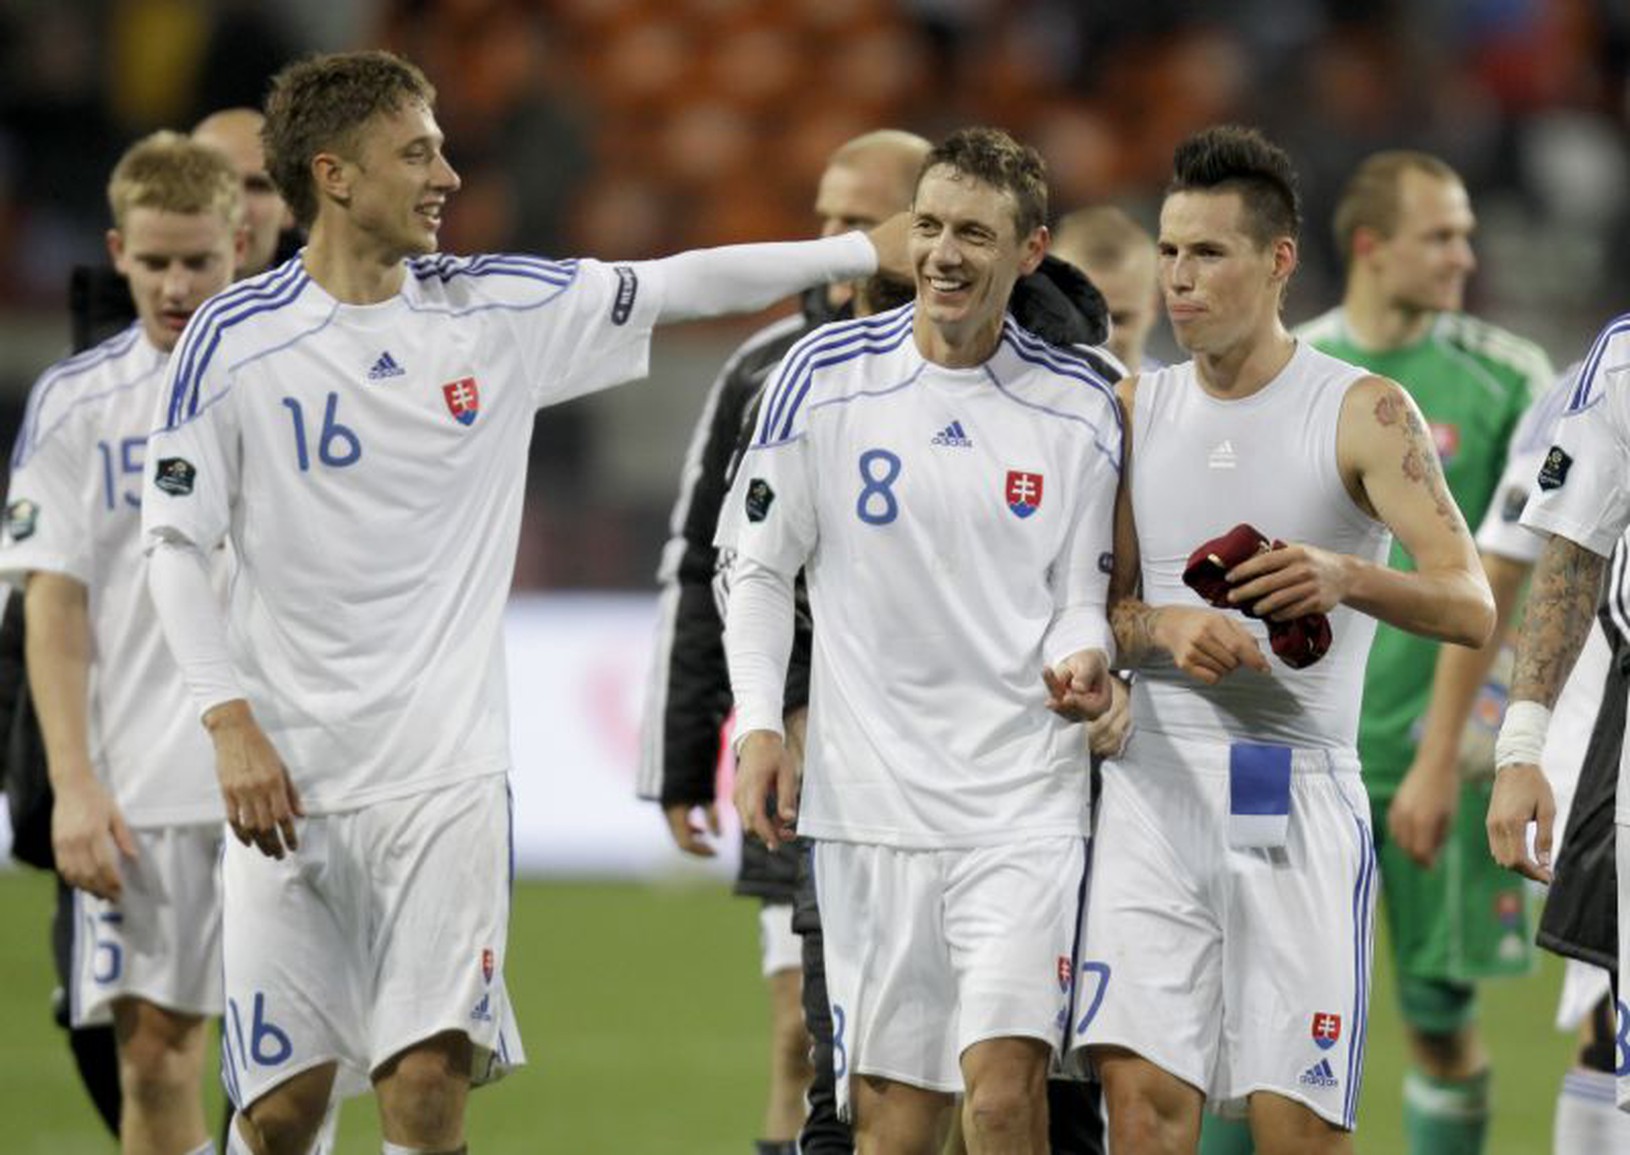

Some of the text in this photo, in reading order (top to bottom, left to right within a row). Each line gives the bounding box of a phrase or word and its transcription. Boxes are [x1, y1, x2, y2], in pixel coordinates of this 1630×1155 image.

[282, 391, 362, 471] 16
[97, 437, 148, 509] 15
[856, 448, 902, 526] 8
[229, 991, 293, 1070] 16
[1077, 962, 1111, 1035] 7
